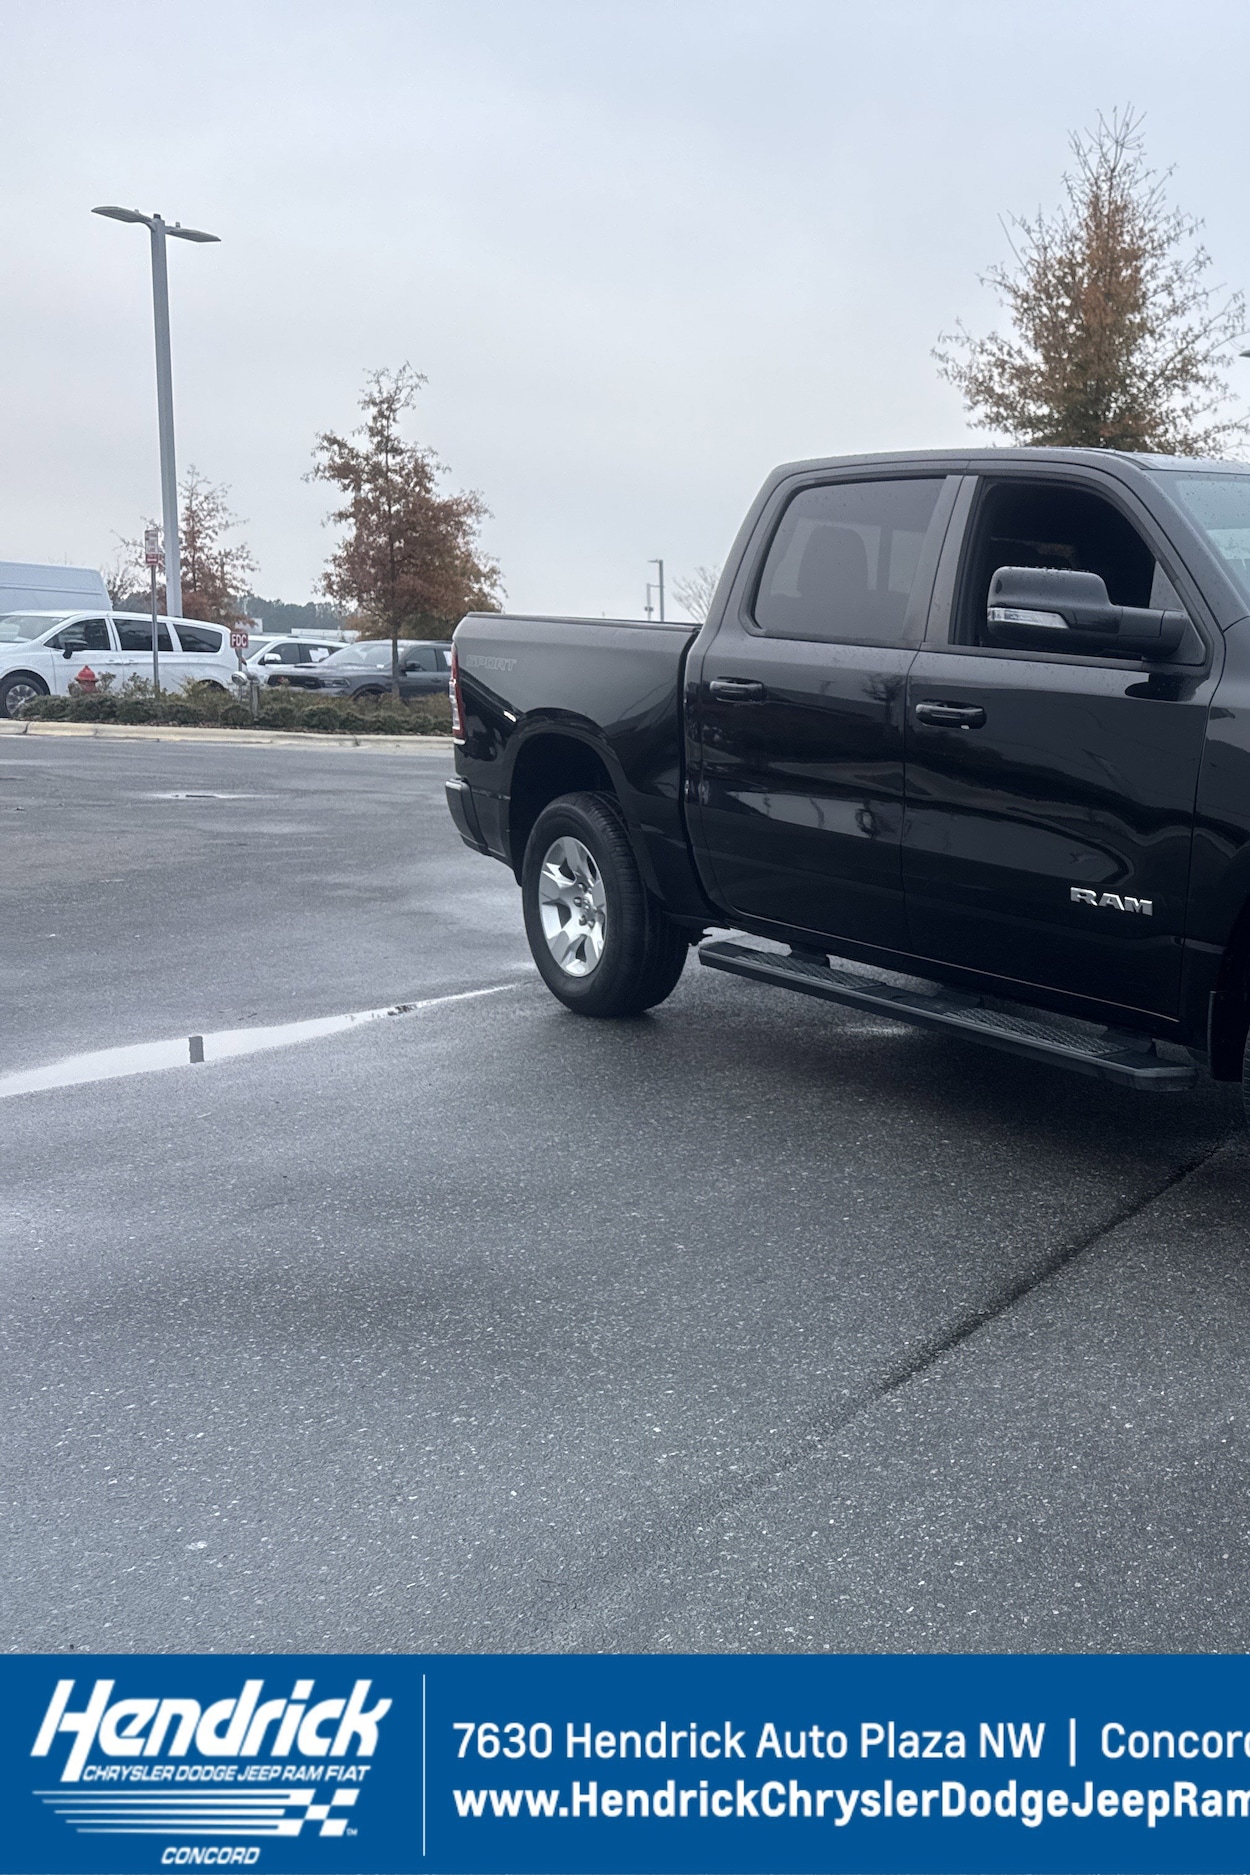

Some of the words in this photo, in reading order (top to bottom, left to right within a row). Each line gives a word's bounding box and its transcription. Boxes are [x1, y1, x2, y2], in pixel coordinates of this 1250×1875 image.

[231, 634, 247, 646] FDC
[466, 655, 517, 671] SPORT
[1070, 886, 1153, 916] RAM
